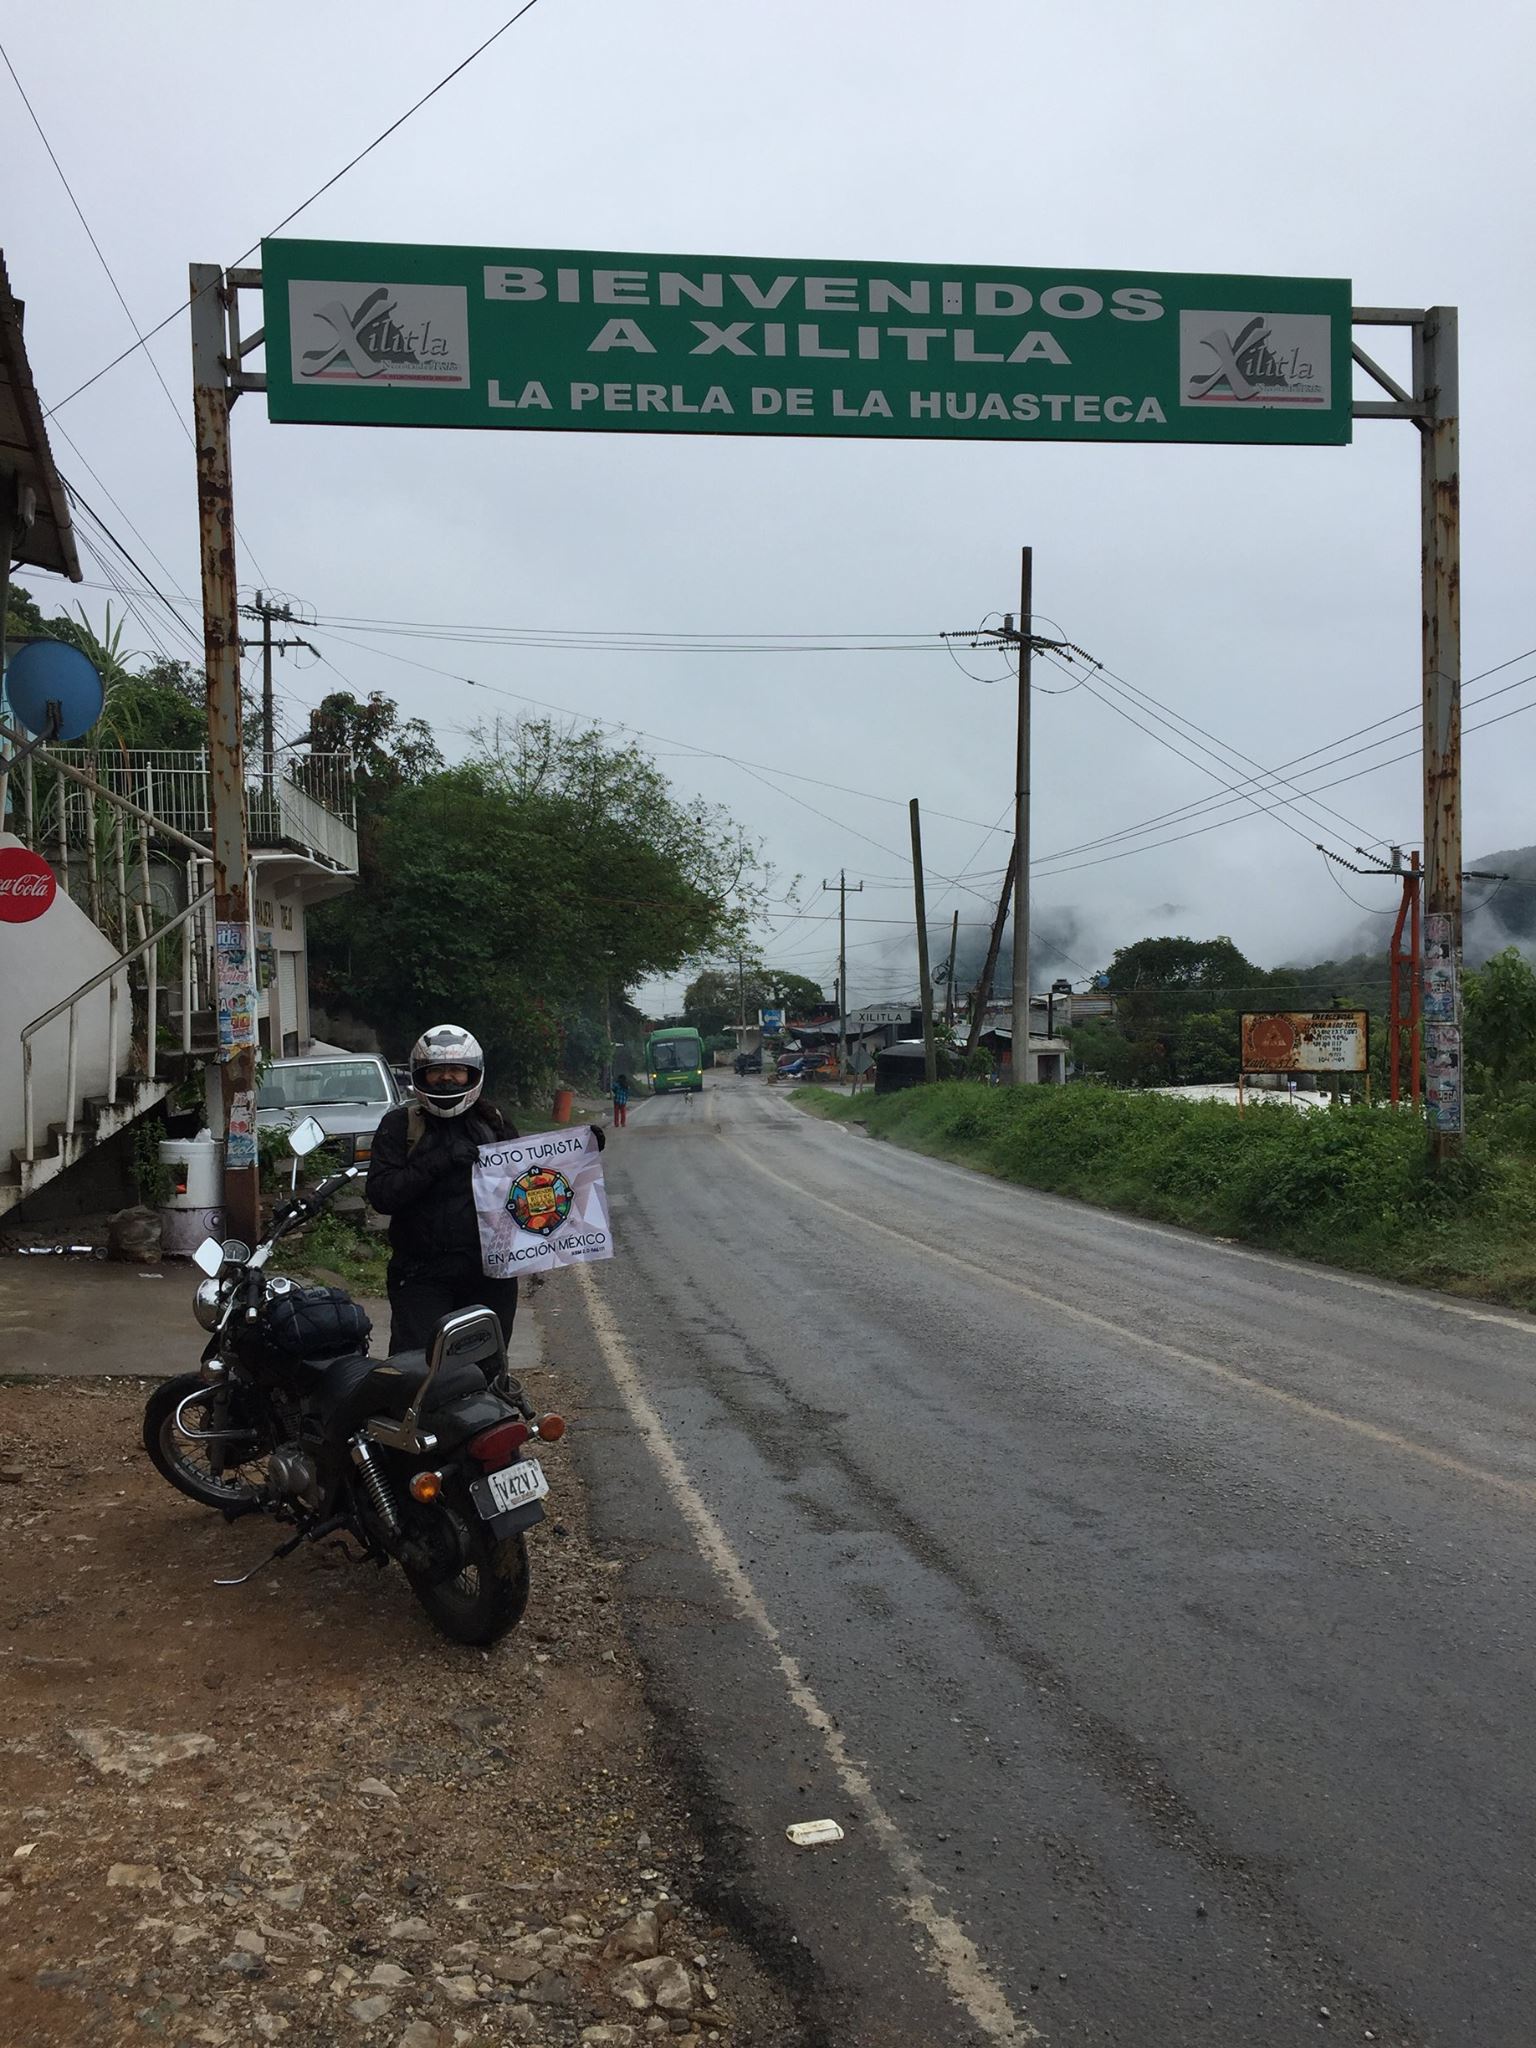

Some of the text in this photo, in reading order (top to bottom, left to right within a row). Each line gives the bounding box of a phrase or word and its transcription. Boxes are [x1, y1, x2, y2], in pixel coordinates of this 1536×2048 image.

[483, 265, 1165, 322] BIENVENIDOS
[301, 287, 450, 378] Xilitla
[587, 318, 1073, 365] A XILITLA
[1188, 316, 1315, 401] Xilitla
[487, 379, 1168, 424] LA PERLA DE LA HUASTECA
[859, 1013, 902, 1021] XILITLA
[478, 1139, 583, 1169] MOTO TURISTA
[487, 1253, 504, 1265] EN
[507, 1241, 556, 1262] ACCIÓN
[559, 1232, 606, 1251] MÉXICO
